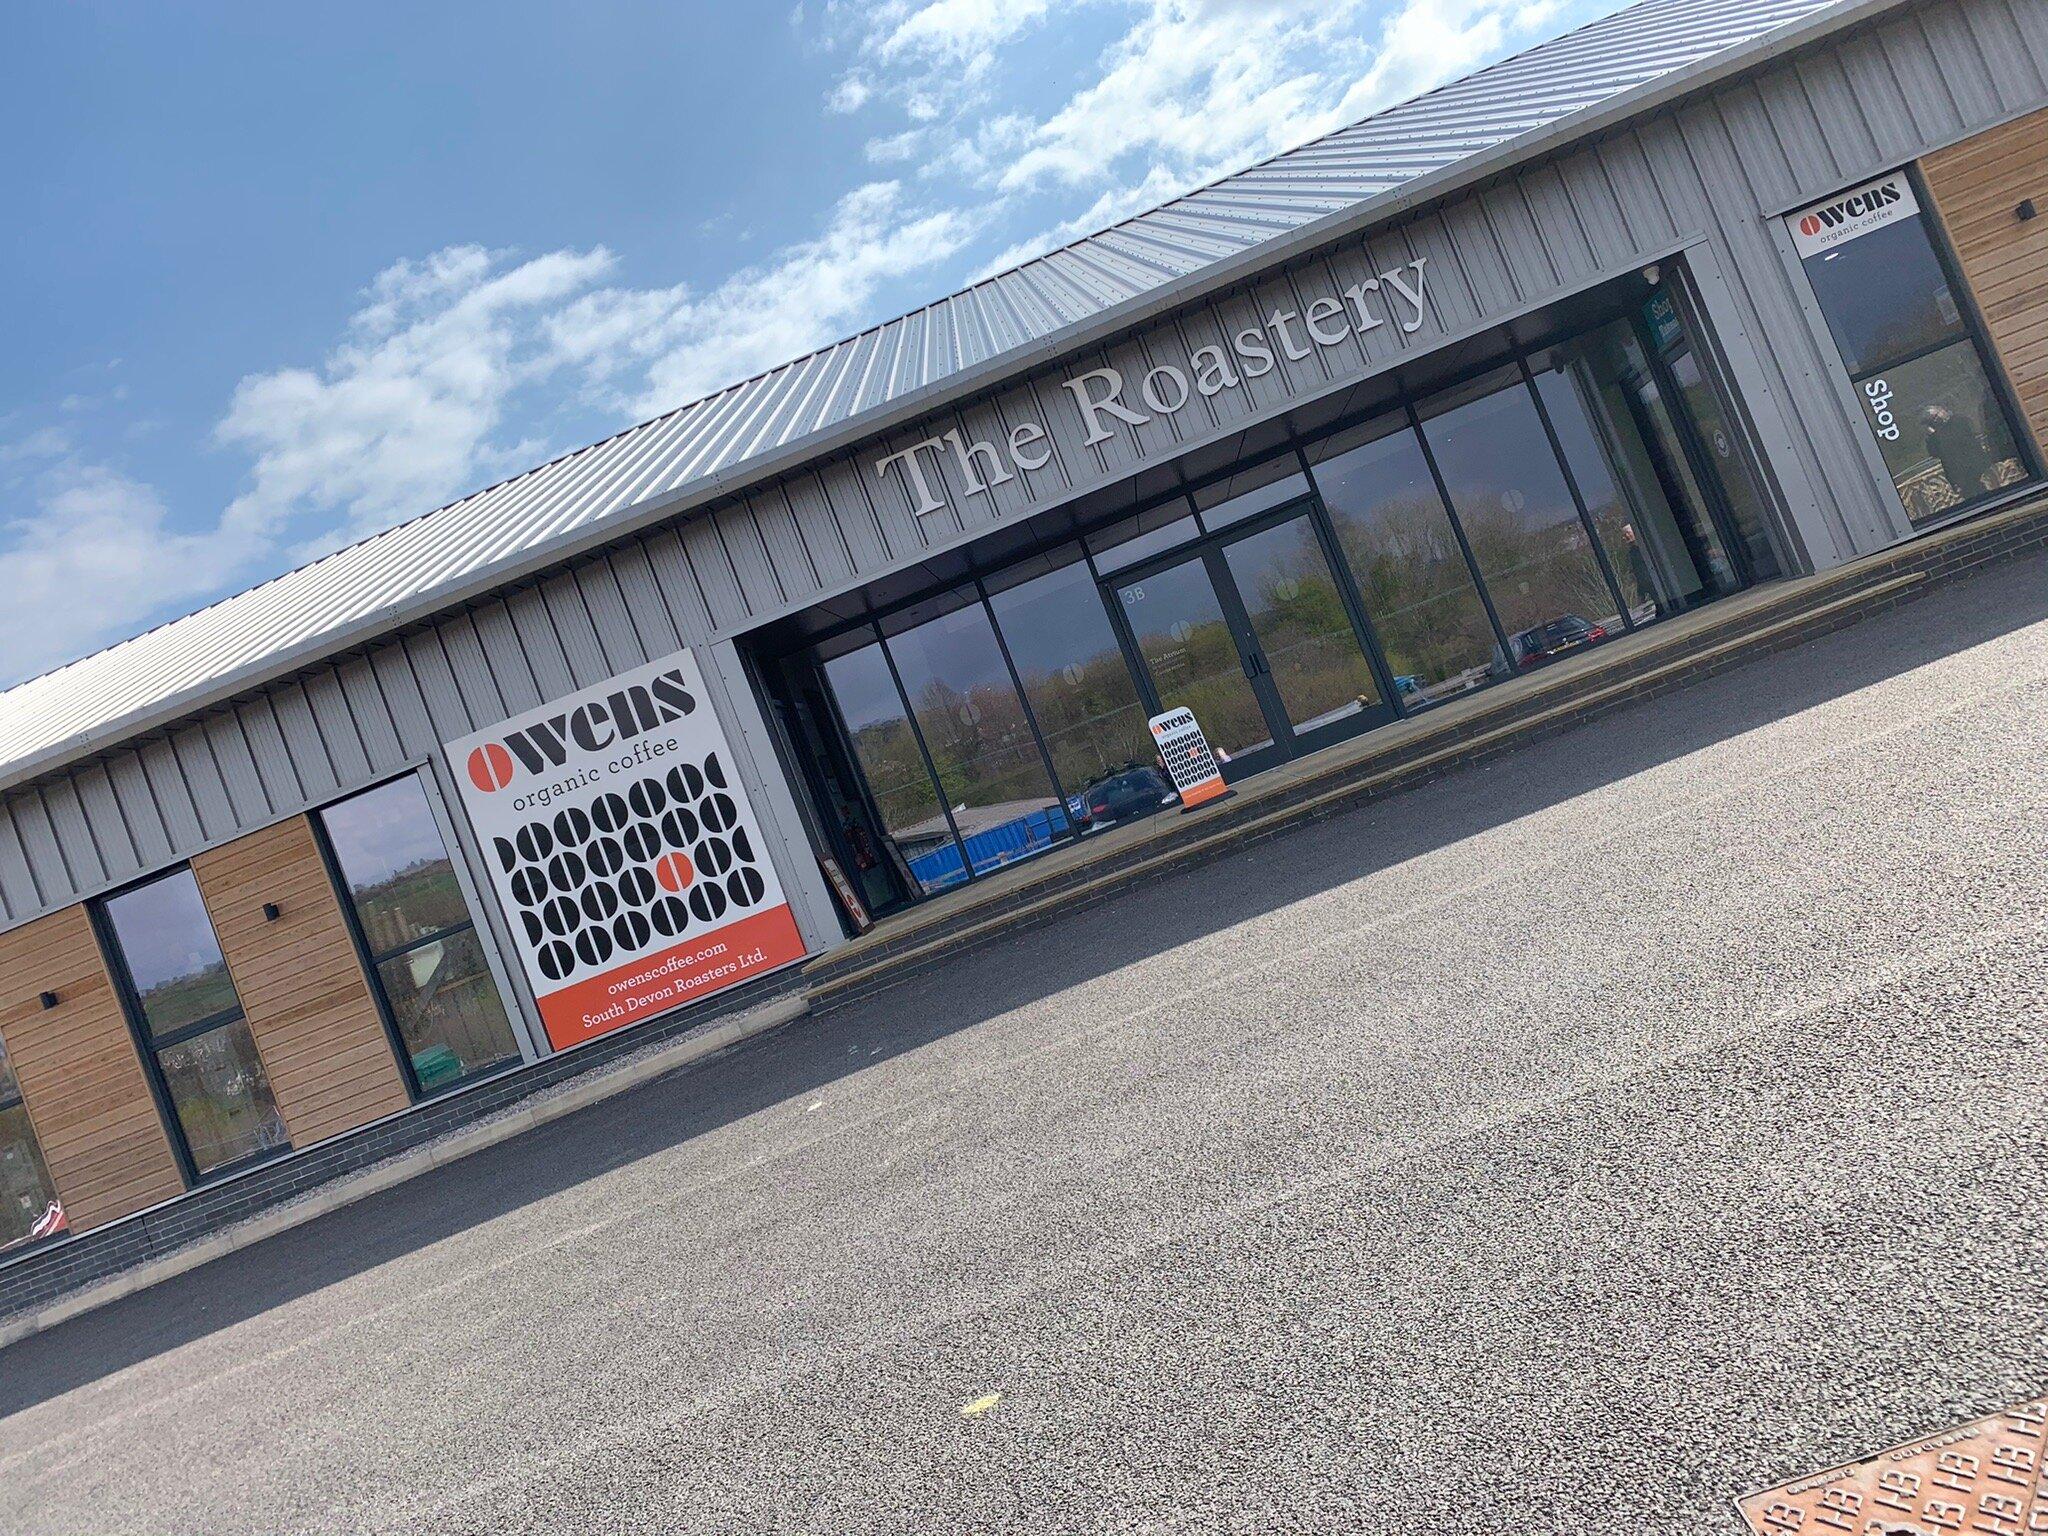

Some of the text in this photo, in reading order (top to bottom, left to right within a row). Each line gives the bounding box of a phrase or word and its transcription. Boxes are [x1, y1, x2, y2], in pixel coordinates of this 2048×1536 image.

[1820, 209, 1893, 244] organic coffee
[876, 256, 1429, 518] The Roastery
[1865, 379, 1900, 442] Shop
[1125, 587, 1145, 604] 3B
[513, 736, 680, 812] organic coffee
[582, 948, 768, 1029] South Devon Roasters Ltd.
[607, 939, 729, 997] owenscoffee.com
